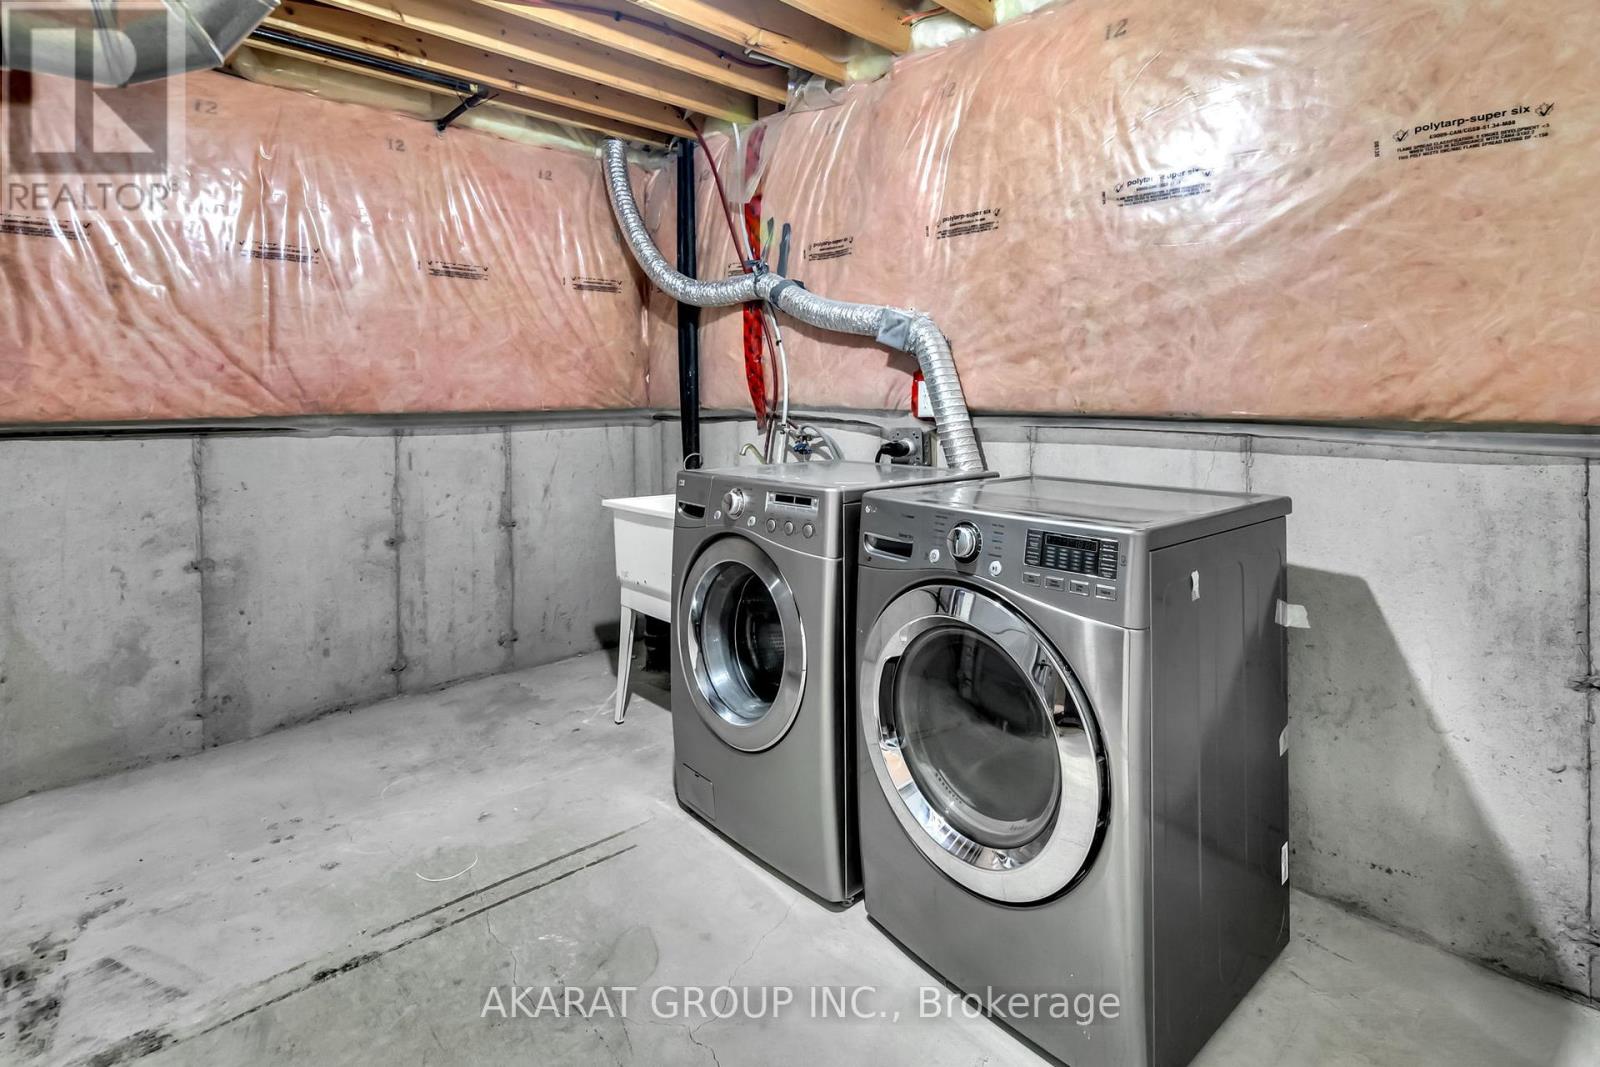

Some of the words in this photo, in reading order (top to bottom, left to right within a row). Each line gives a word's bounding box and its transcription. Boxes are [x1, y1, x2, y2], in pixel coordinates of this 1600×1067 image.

[1105, 18, 1128, 41] 12
[194, 99, 217, 115] 12
[1414, 109, 1508, 134] polytarp-super
[1511, 105, 1531, 116] six
[386, 136, 405, 152] 12
[538, 169, 553, 181] 12
